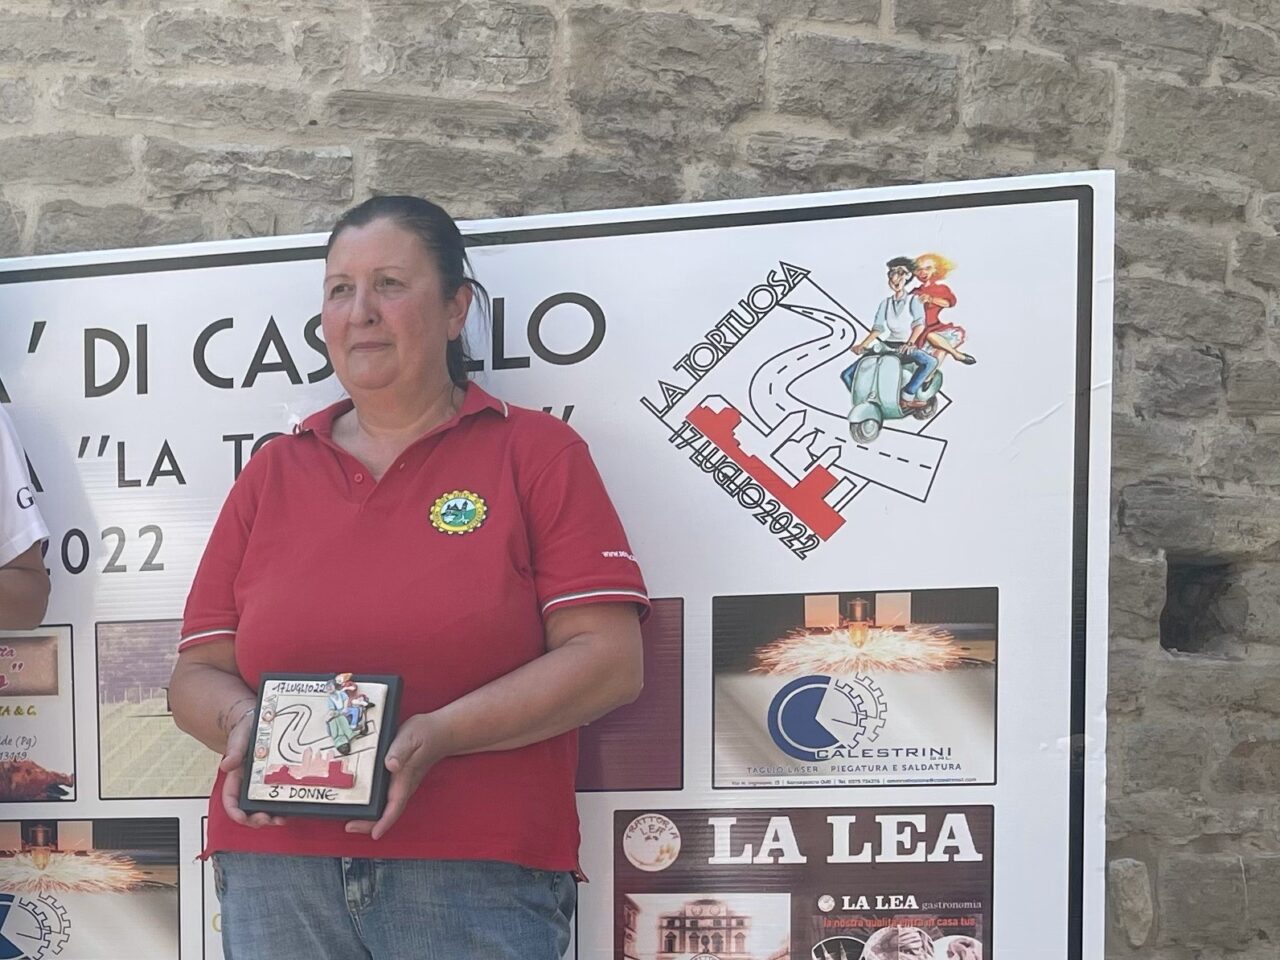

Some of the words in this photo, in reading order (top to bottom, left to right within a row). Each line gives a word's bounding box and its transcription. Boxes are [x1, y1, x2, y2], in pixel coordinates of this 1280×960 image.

[639, 380, 687, 419] LA
[672, 260, 812, 383] TORTUOSA
[84, 323, 148, 398] DI
[751, 498, 821, 561] 2022
[41, 524, 165, 576] 022
[14, 704, 23, 716] &
[815, 746, 952, 759] CALESTRINI
[830, 764, 888, 772] PIEGATURA
[902, 763, 962, 771] SALDATURA
[288, 787, 340, 801] DONNE
[707, 815, 807, 865] LA
[826, 812, 984, 864] LEA
[841, 895, 870, 910] LA
[874, 894, 919, 910] LEA
[921, 900, 983, 911] gastronomia
